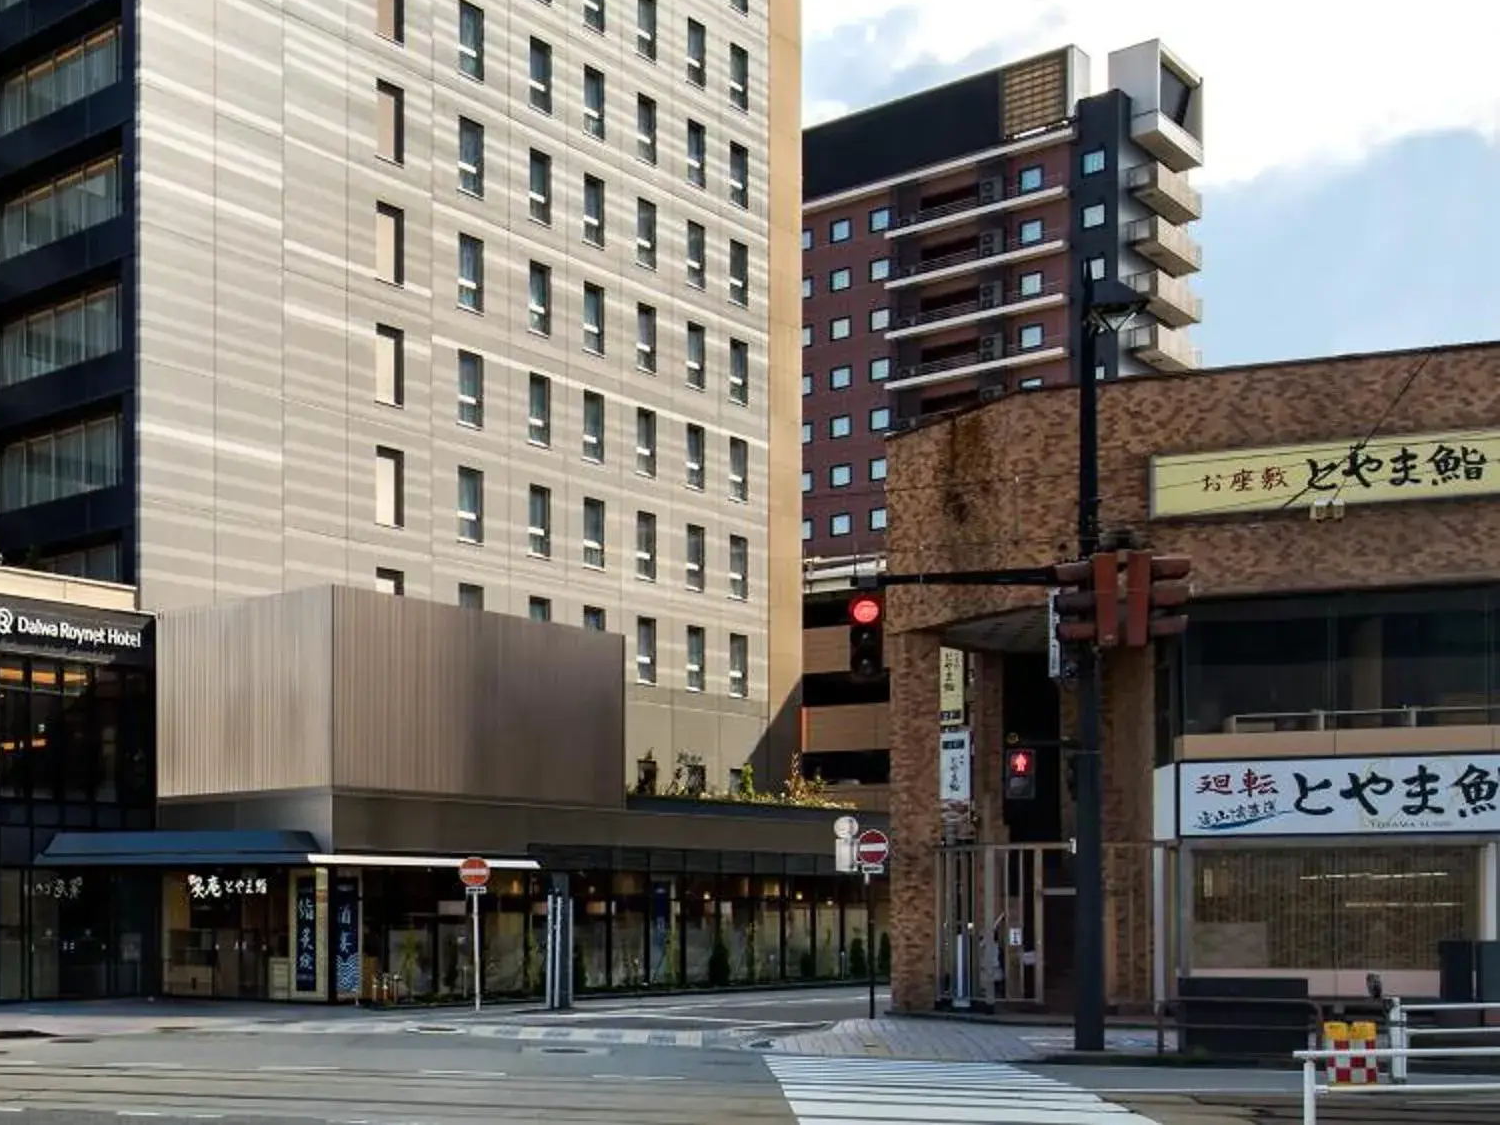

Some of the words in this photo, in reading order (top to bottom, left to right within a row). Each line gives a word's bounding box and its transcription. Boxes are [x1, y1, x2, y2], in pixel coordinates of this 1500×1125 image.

[1202, 466, 1289, 492] お座敷
[1306, 443, 1487, 491] とやま鮨
[17, 616, 58, 637] Daiwa
[60, 622, 106, 644] Roynet
[107, 631, 141, 648] Hotel
[1196, 768, 1279, 797] 廻転
